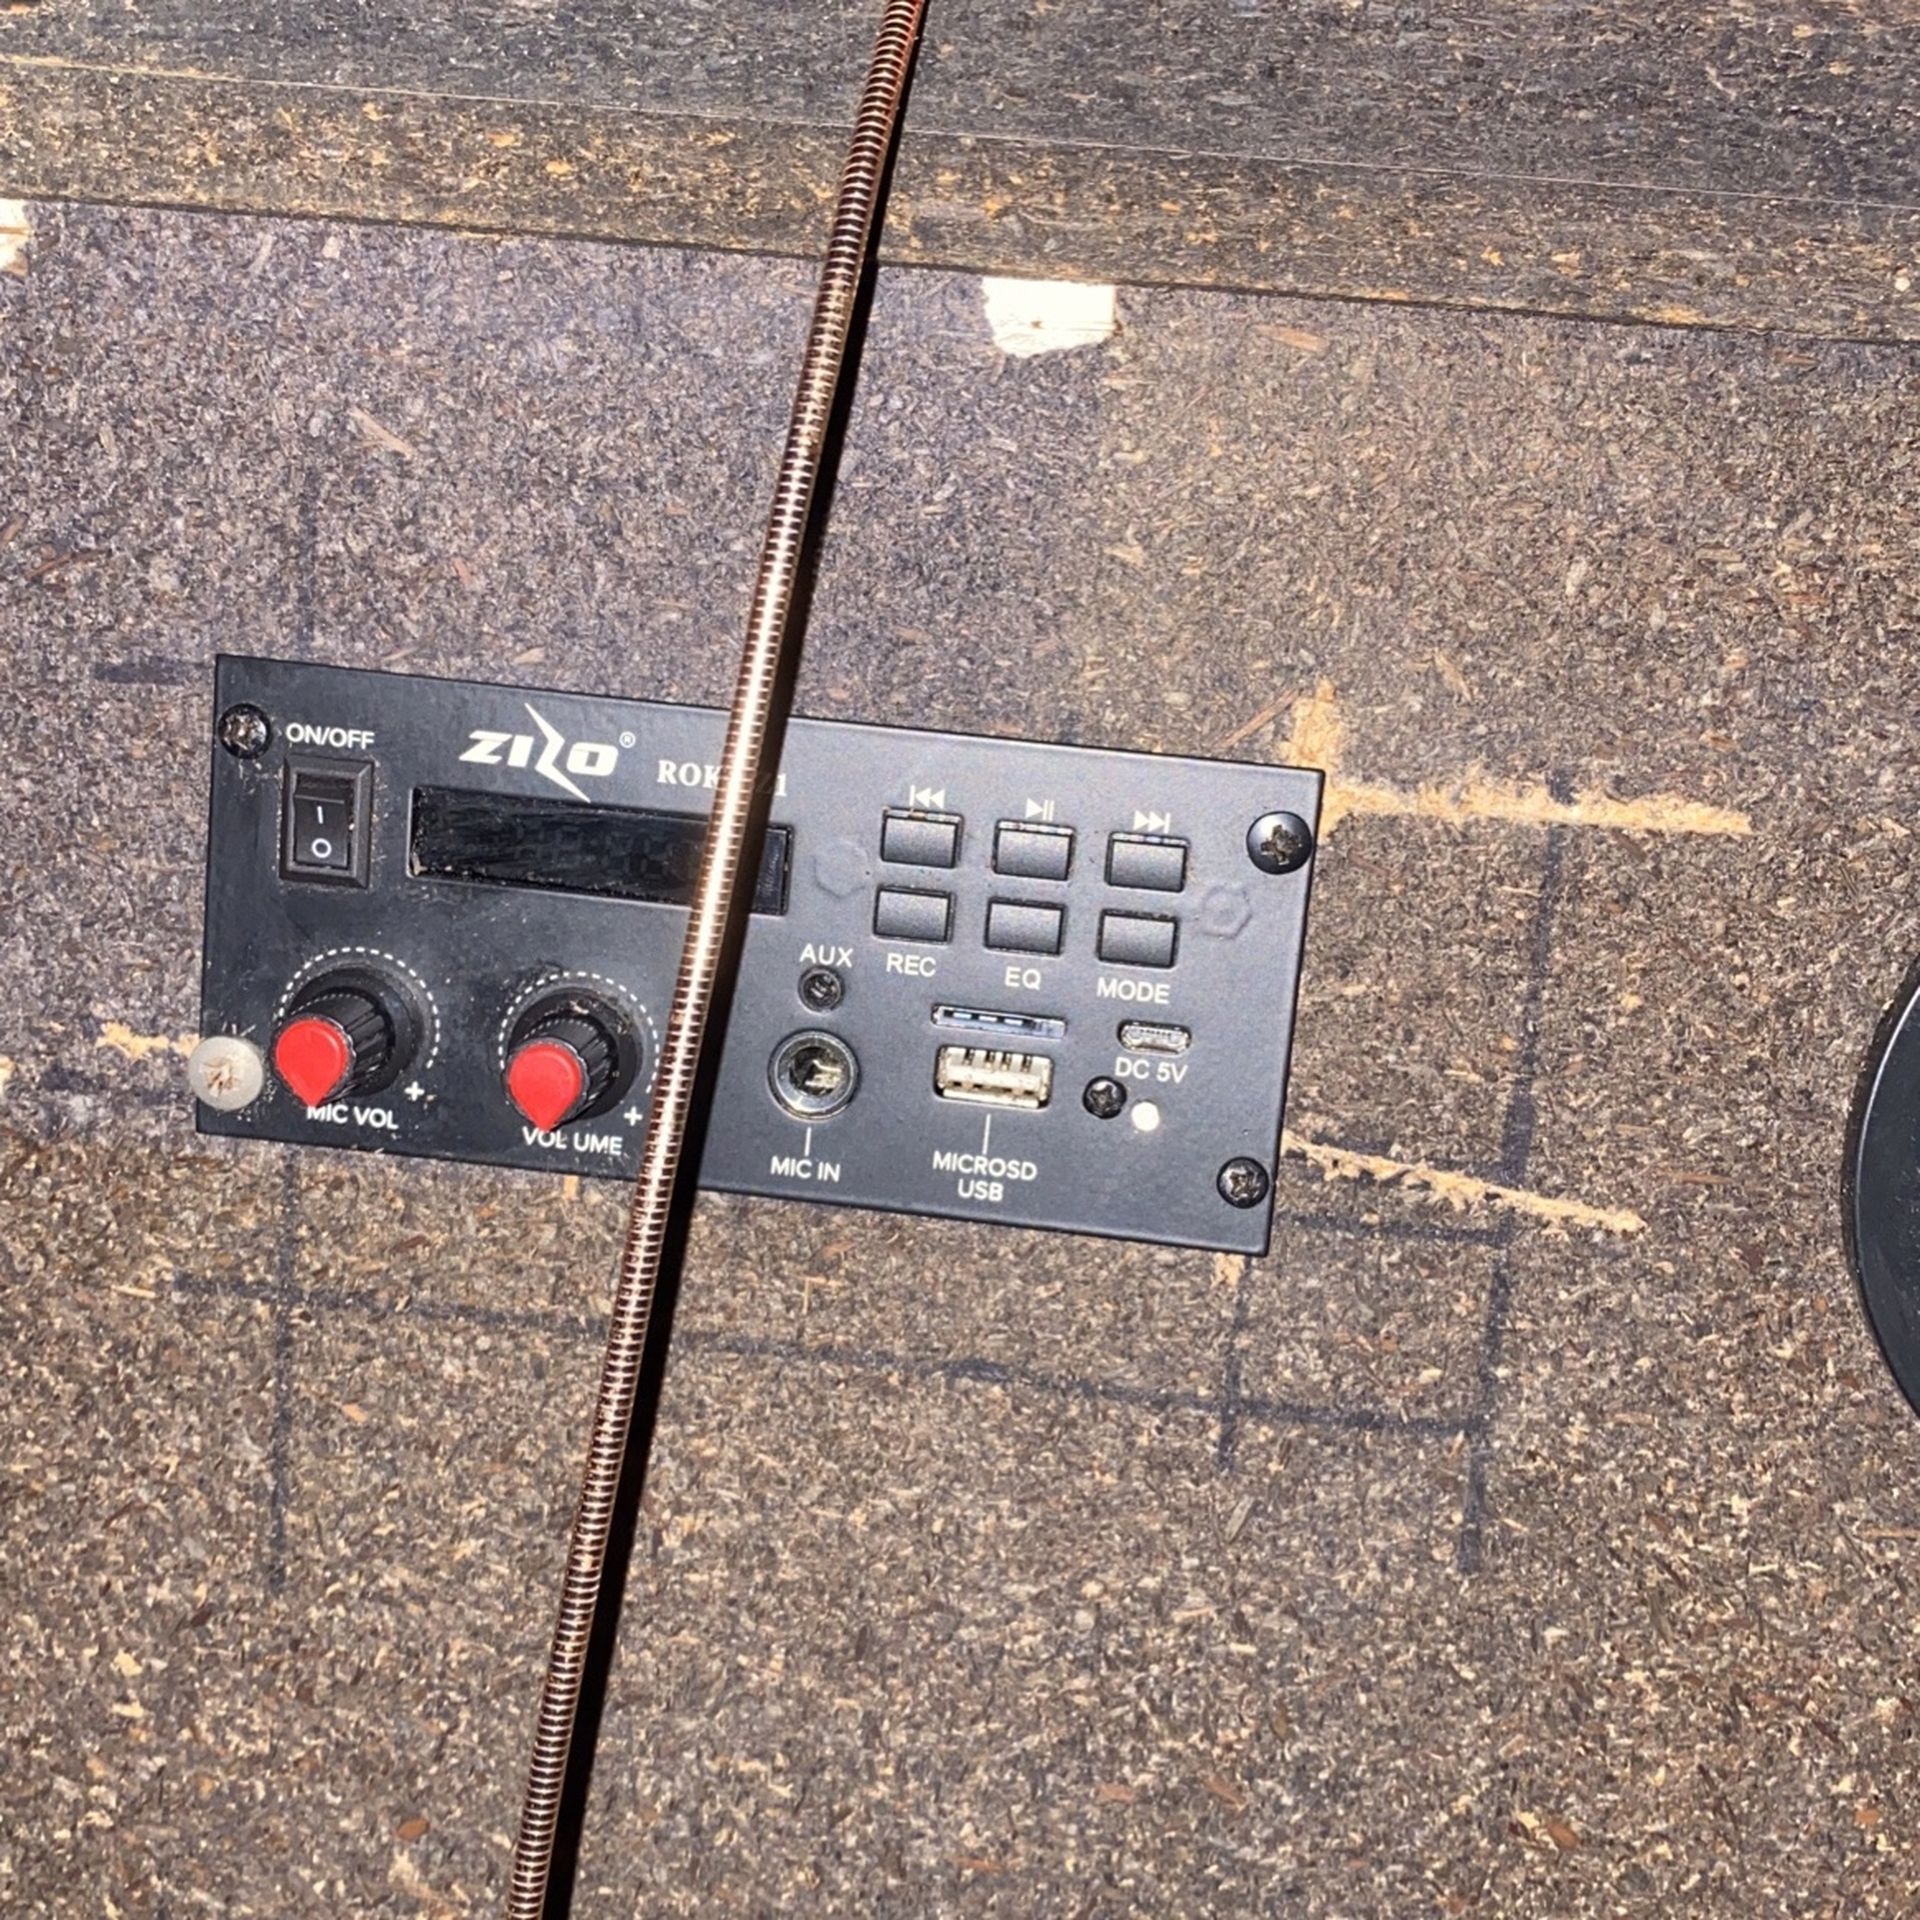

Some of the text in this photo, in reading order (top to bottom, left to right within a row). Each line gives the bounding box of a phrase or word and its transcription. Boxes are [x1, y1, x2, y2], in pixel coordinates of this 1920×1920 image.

[285, 722, 375, 750] ON/OFF
[799, 943, 854, 968] AUX
[886, 952, 937, 977] REC
[1005, 966, 1042, 990] EQ
[1097, 977, 1171, 1004] MODE
[1115, 1056, 1188, 1084] DC 5V
[307, 1103, 399, 1130] MIC VOL
[770, 1156, 841, 1183] MIC IN
[932, 1151, 1038, 1182] MICROSD
[957, 1178, 1005, 1202] USB
